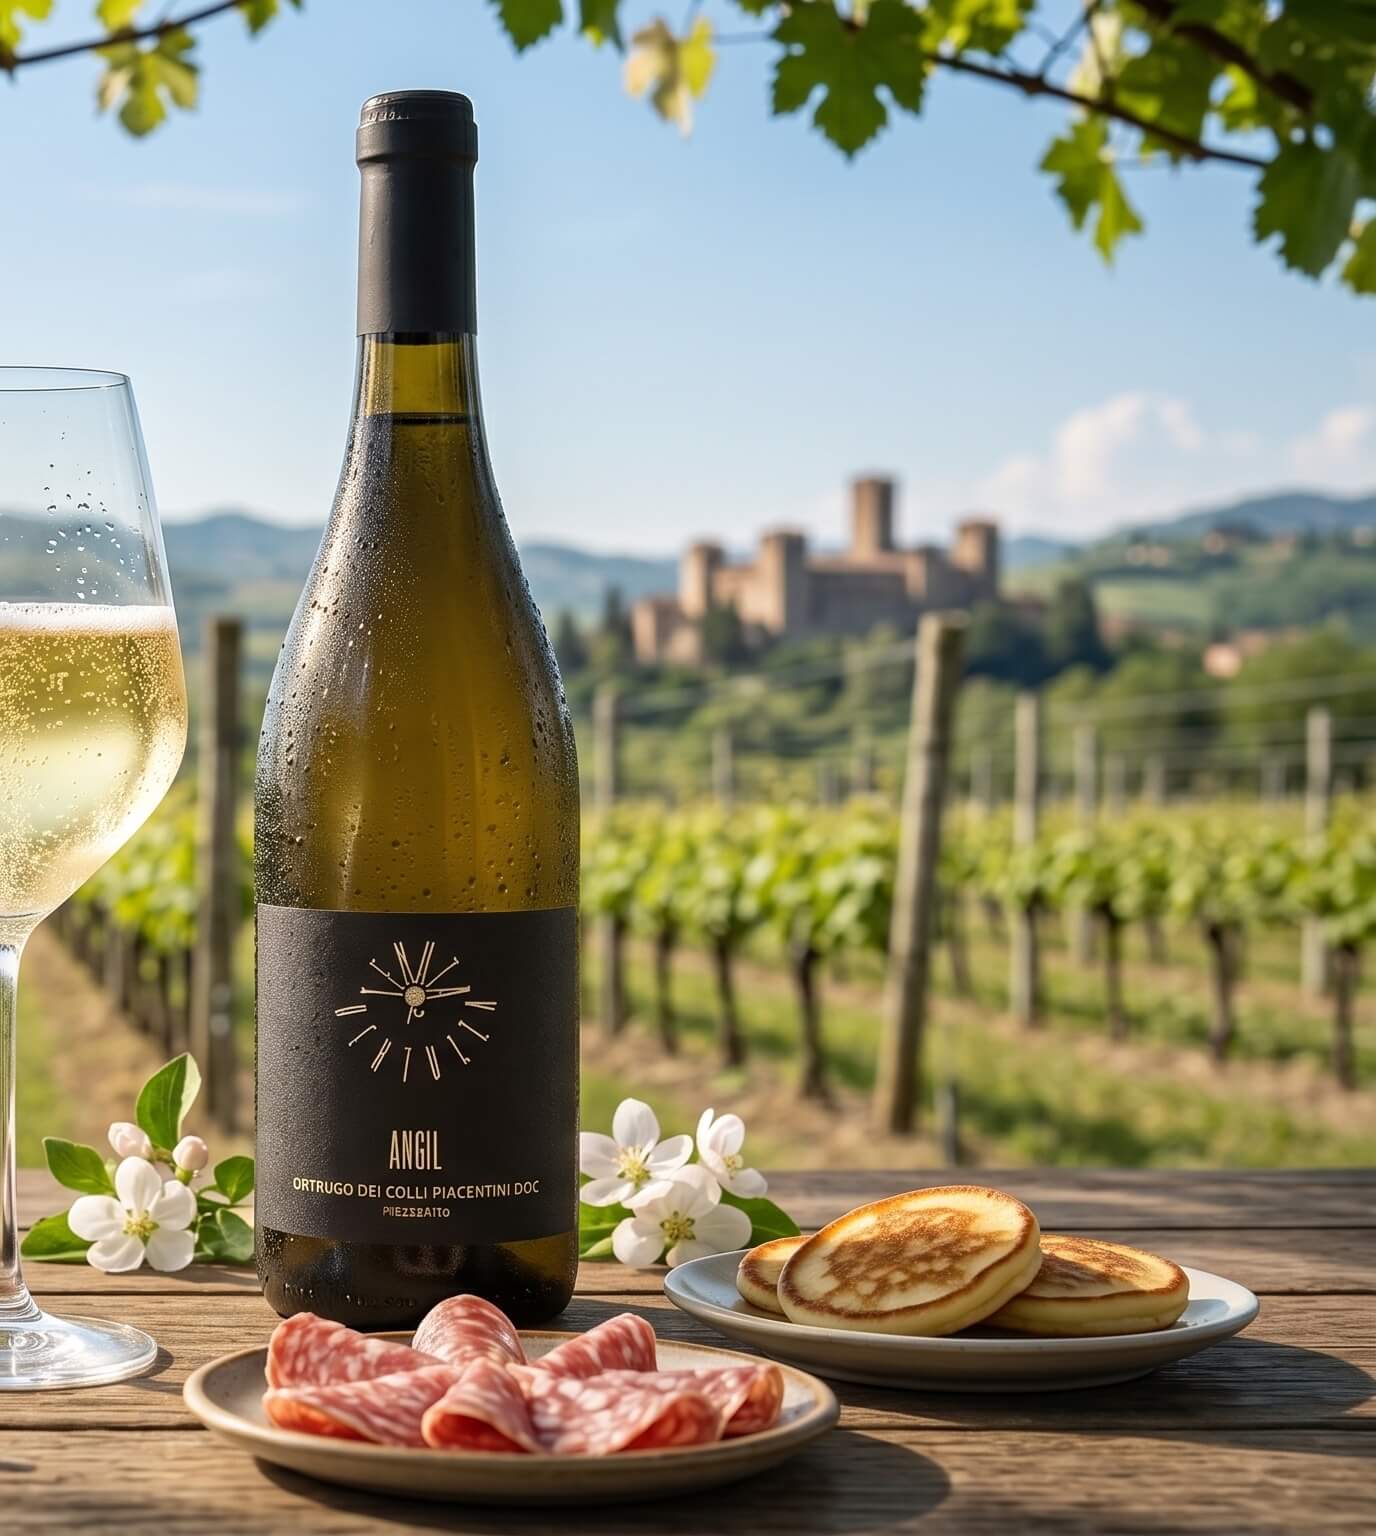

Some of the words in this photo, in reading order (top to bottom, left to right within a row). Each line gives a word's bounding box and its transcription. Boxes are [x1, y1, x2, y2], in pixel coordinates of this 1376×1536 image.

[389, 1130, 442, 1170] ANGIL
[293, 1177, 354, 1196] ORTRUGO
[357, 1184, 381, 1199] DEI
[385, 1186, 427, 1200] COLLI
[432, 1183, 510, 1200] PIACENTINI
[514, 1180, 540, 1196] DOC
